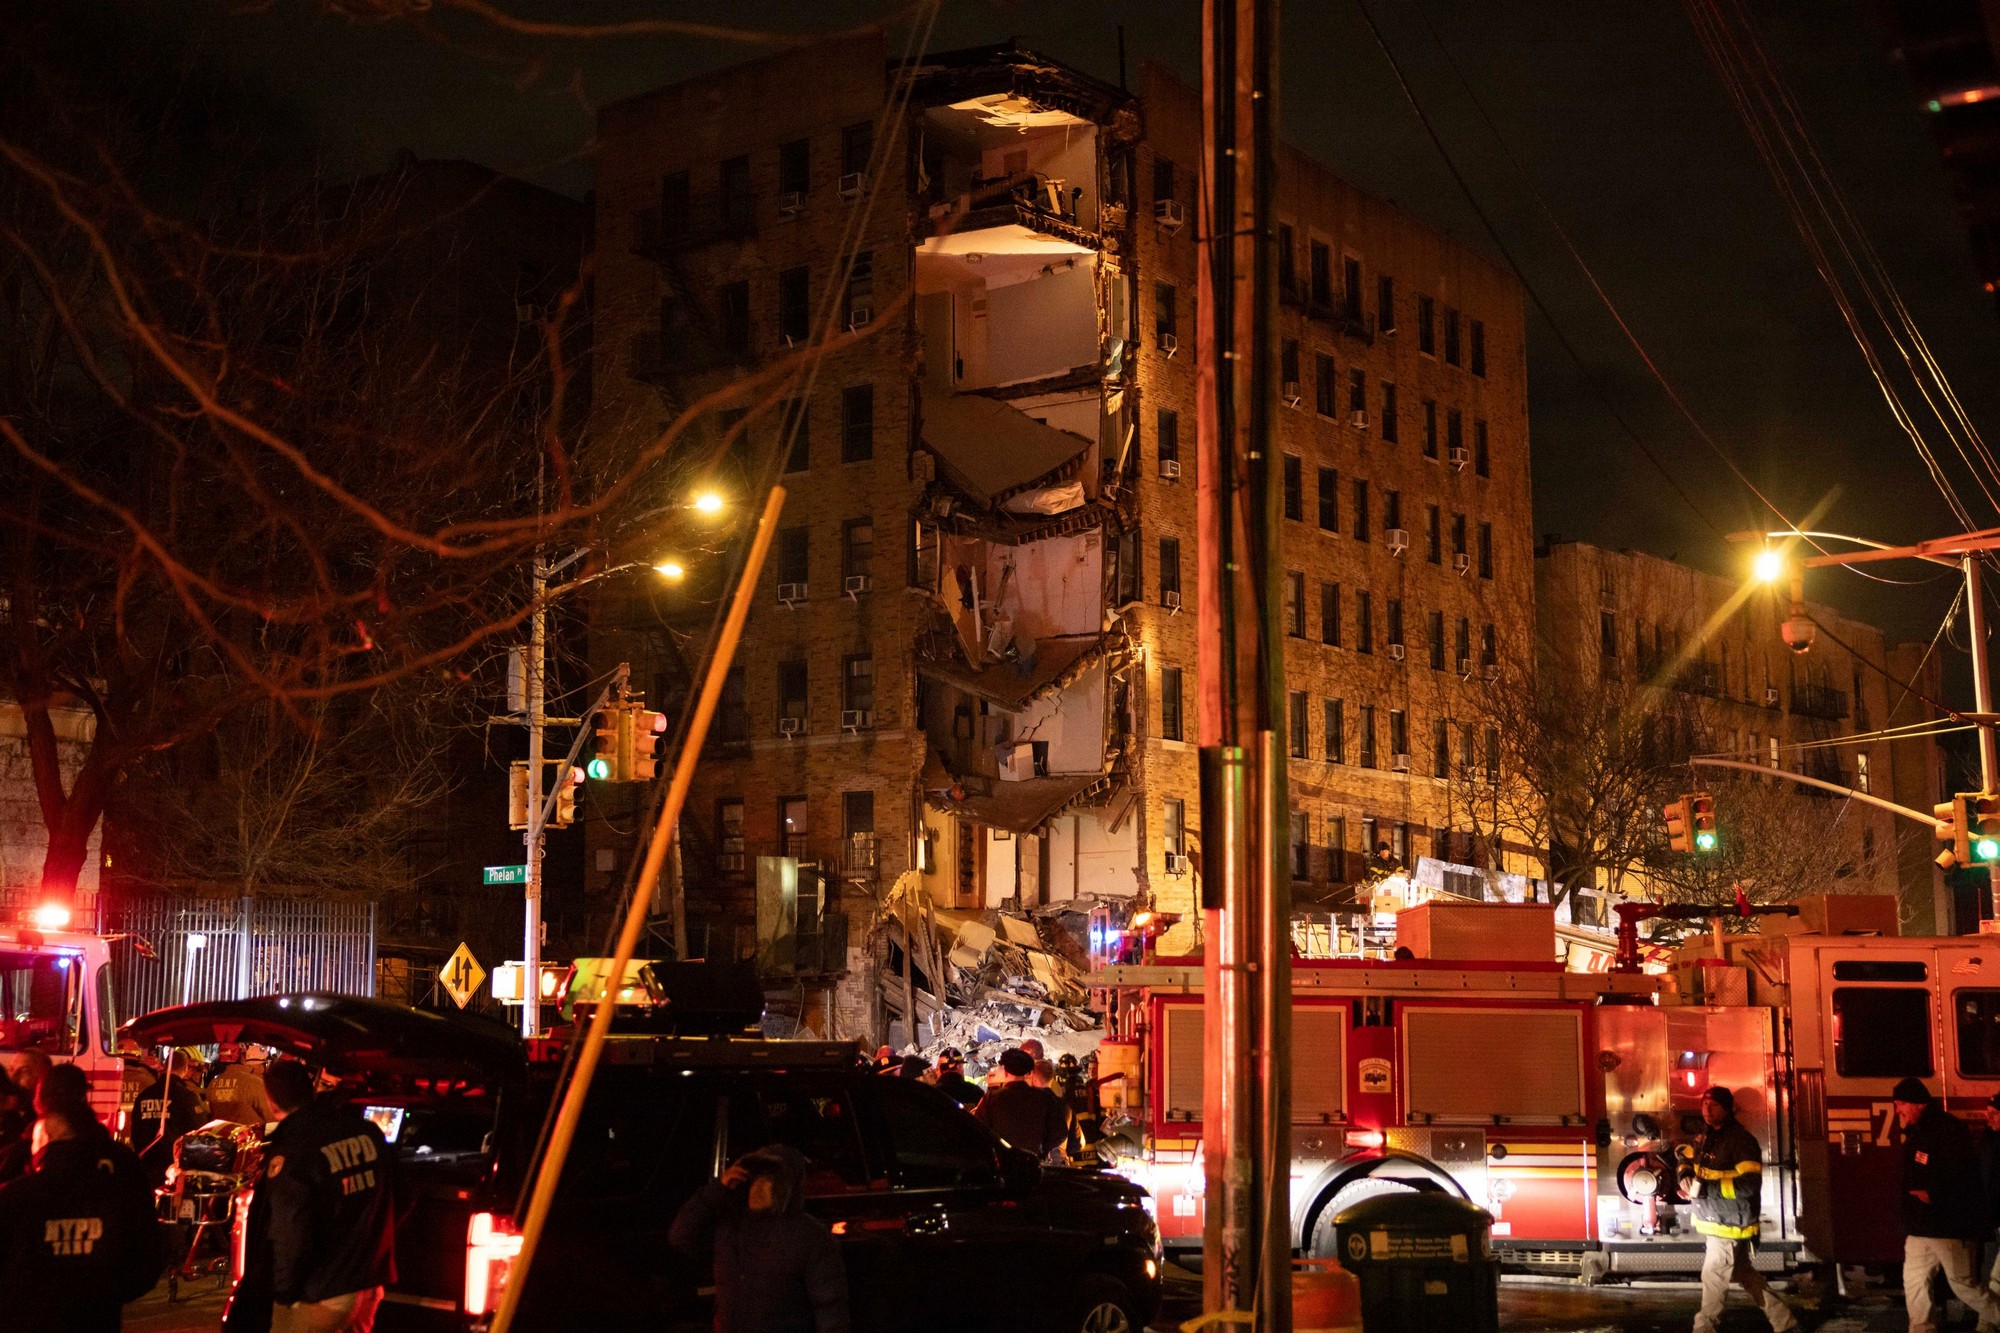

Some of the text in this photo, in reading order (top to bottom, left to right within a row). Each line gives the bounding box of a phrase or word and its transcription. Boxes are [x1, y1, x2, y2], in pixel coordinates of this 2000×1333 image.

[489, 868, 515, 882] Phelan
[1872, 1102, 1906, 1147] 7
[320, 1134, 378, 1174] NYPD
[43, 1217, 104, 1242] NYPD
